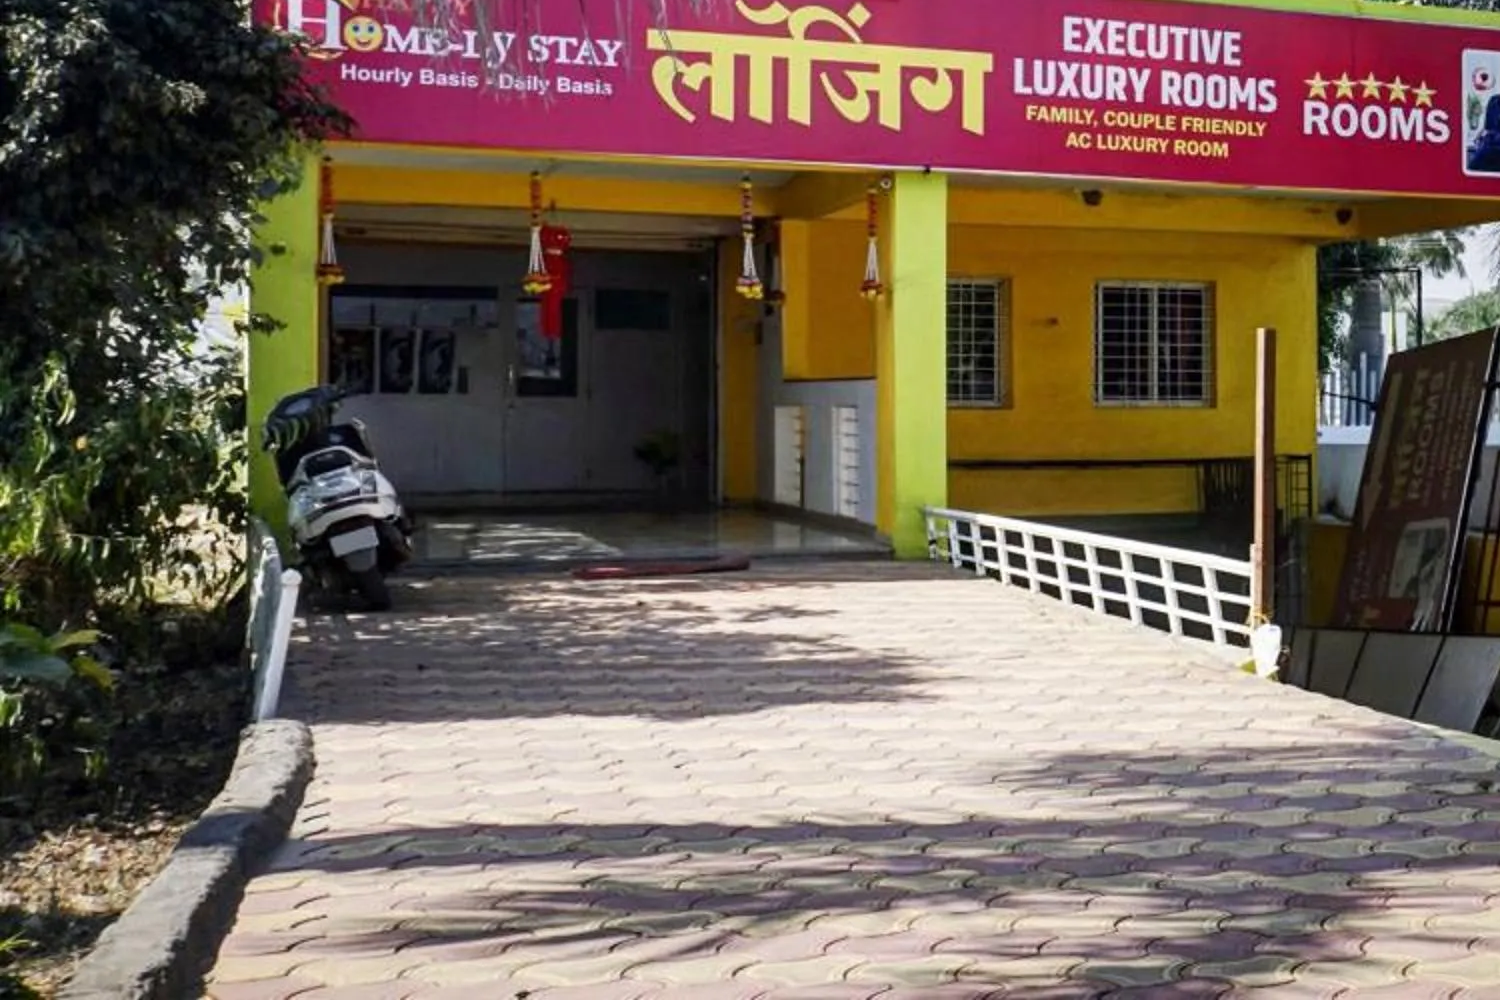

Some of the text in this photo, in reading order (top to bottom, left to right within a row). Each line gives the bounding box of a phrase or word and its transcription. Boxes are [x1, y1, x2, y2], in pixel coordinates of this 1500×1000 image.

[527, 34, 623, 67] STAY
[1062, 15, 1242, 67] EXECUTIVE
[341, 63, 413, 87] Hourly
[419, 68, 479, 88] Basis
[499, 73, 550, 95] Daily
[557, 76, 613, 96] Basis
[1012, 57, 1278, 113] LUXURY ROOMS
[1025, 104, 1268, 137] FAMILY, COUPLE FRIENDLY
[1302, 100, 1451, 144] ROOMS
[1066, 131, 1229, 159] AC LUXURY ROOM
